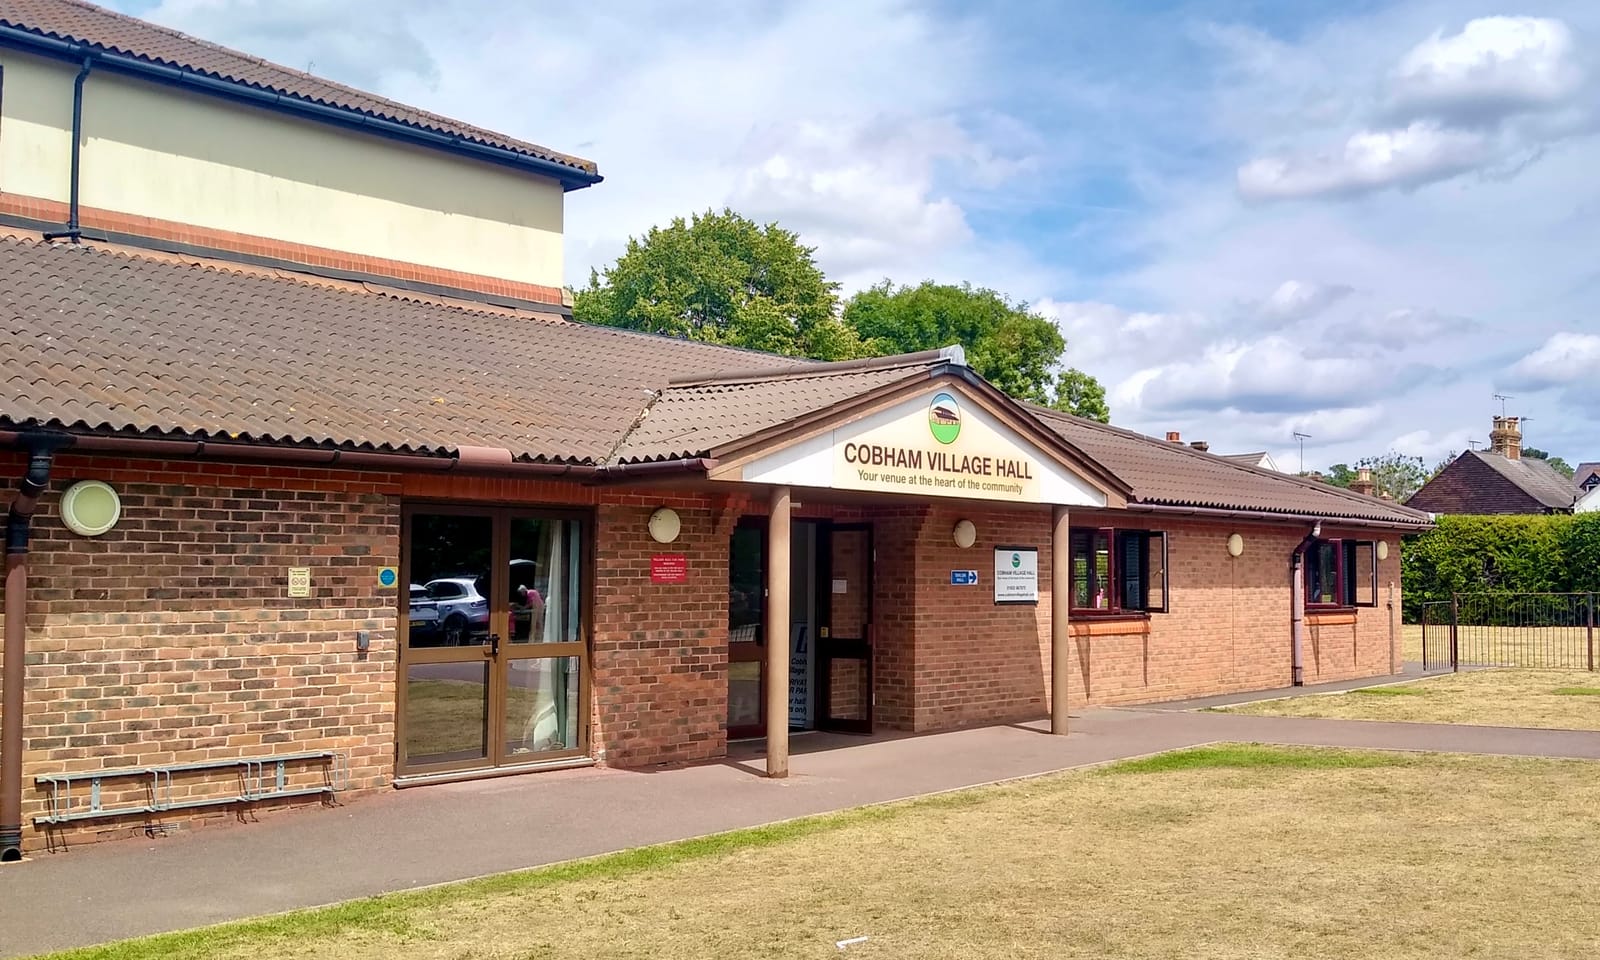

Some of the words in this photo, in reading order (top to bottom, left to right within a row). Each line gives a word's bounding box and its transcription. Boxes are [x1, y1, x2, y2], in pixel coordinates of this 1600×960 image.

[844, 442, 922, 470] COBHAM
[927, 451, 992, 476] VILLAGE
[996, 459, 1033, 480] HALL
[857, 469, 878, 481] Your
[880, 474, 906, 484] venue
[908, 474, 918, 485] at
[919, 475, 933, 486] the
[934, 476, 956, 488] heart
[957, 478, 967, 489] of
[967, 479, 980, 490] the
[981, 481, 1023, 495] community
